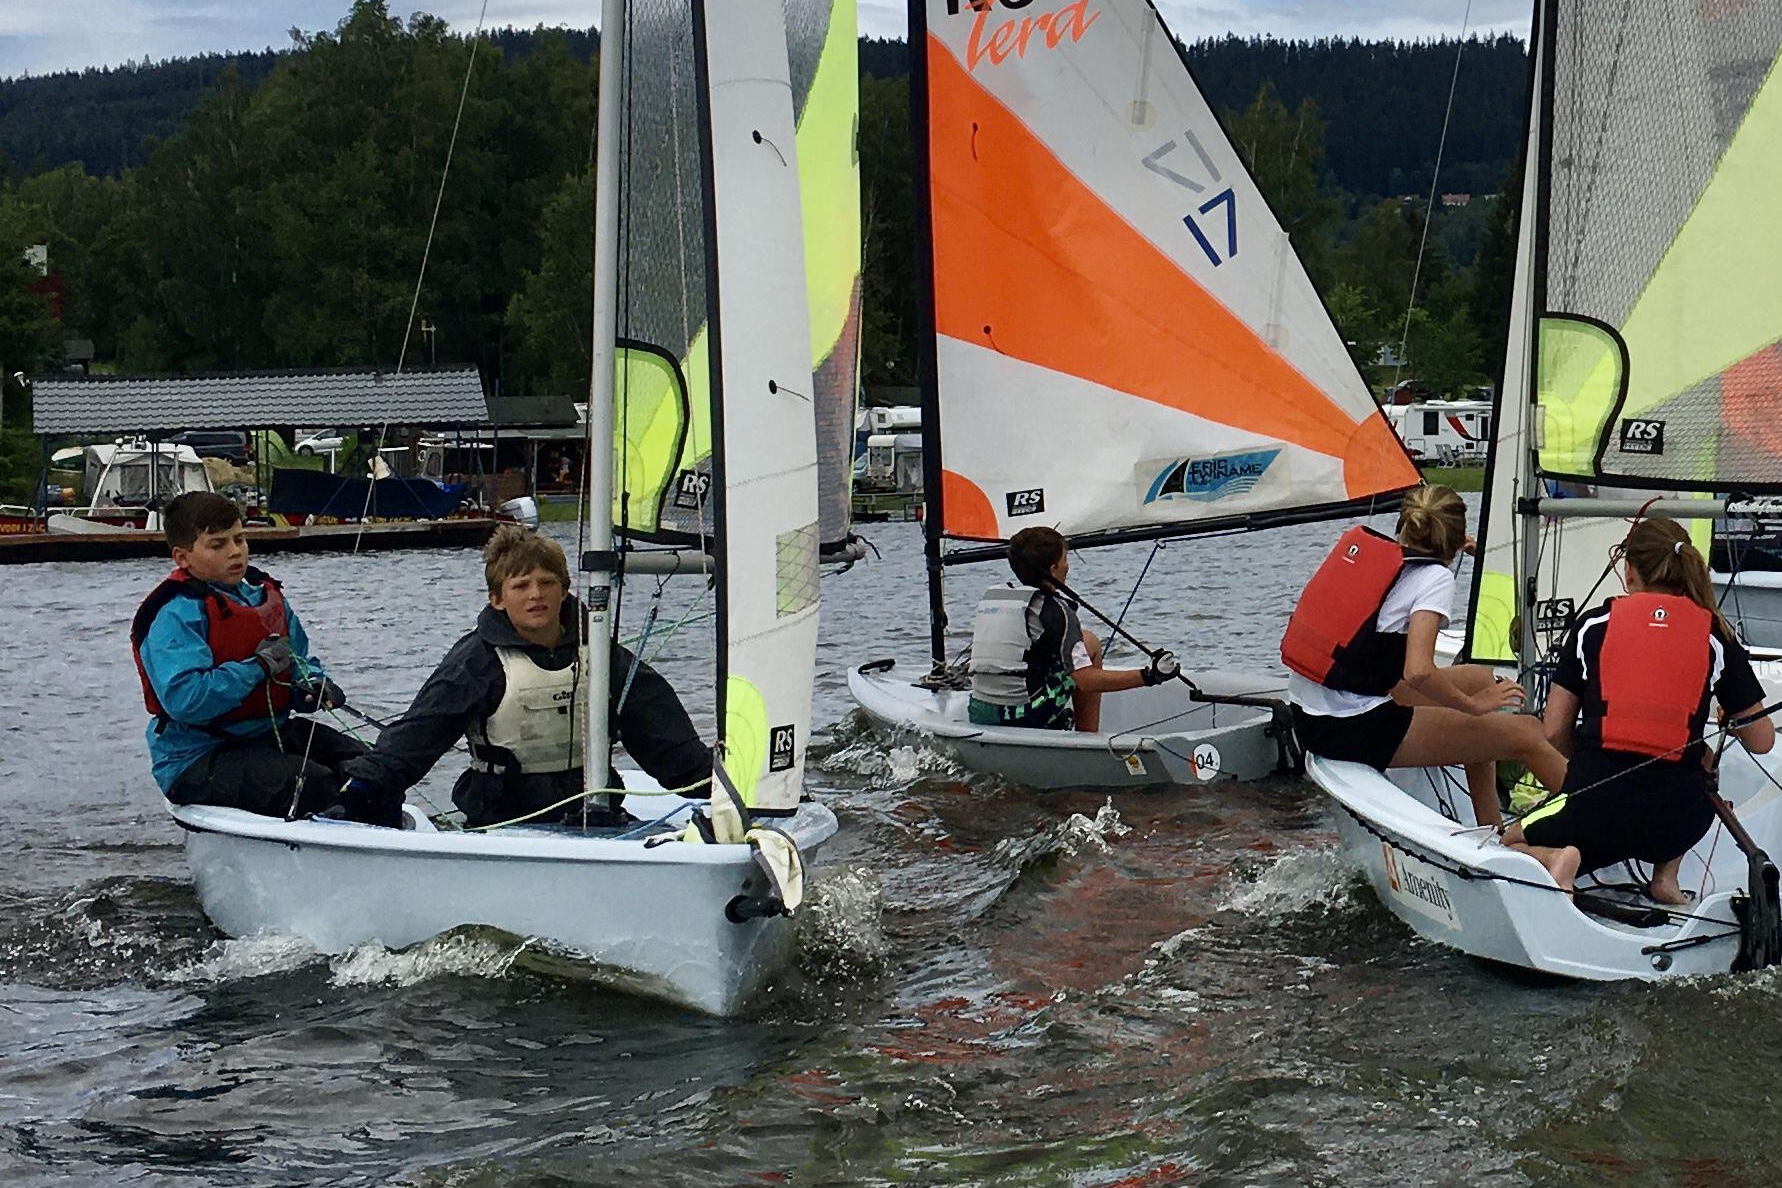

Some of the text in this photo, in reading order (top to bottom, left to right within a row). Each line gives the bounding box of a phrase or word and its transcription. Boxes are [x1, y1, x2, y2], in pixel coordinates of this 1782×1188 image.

[1182, 188, 1238, 267] 17
[1627, 421, 1661, 439] RS
[682, 473, 709, 493] RS
[1013, 490, 1041, 505] RS
[775, 729, 793, 752] RS
